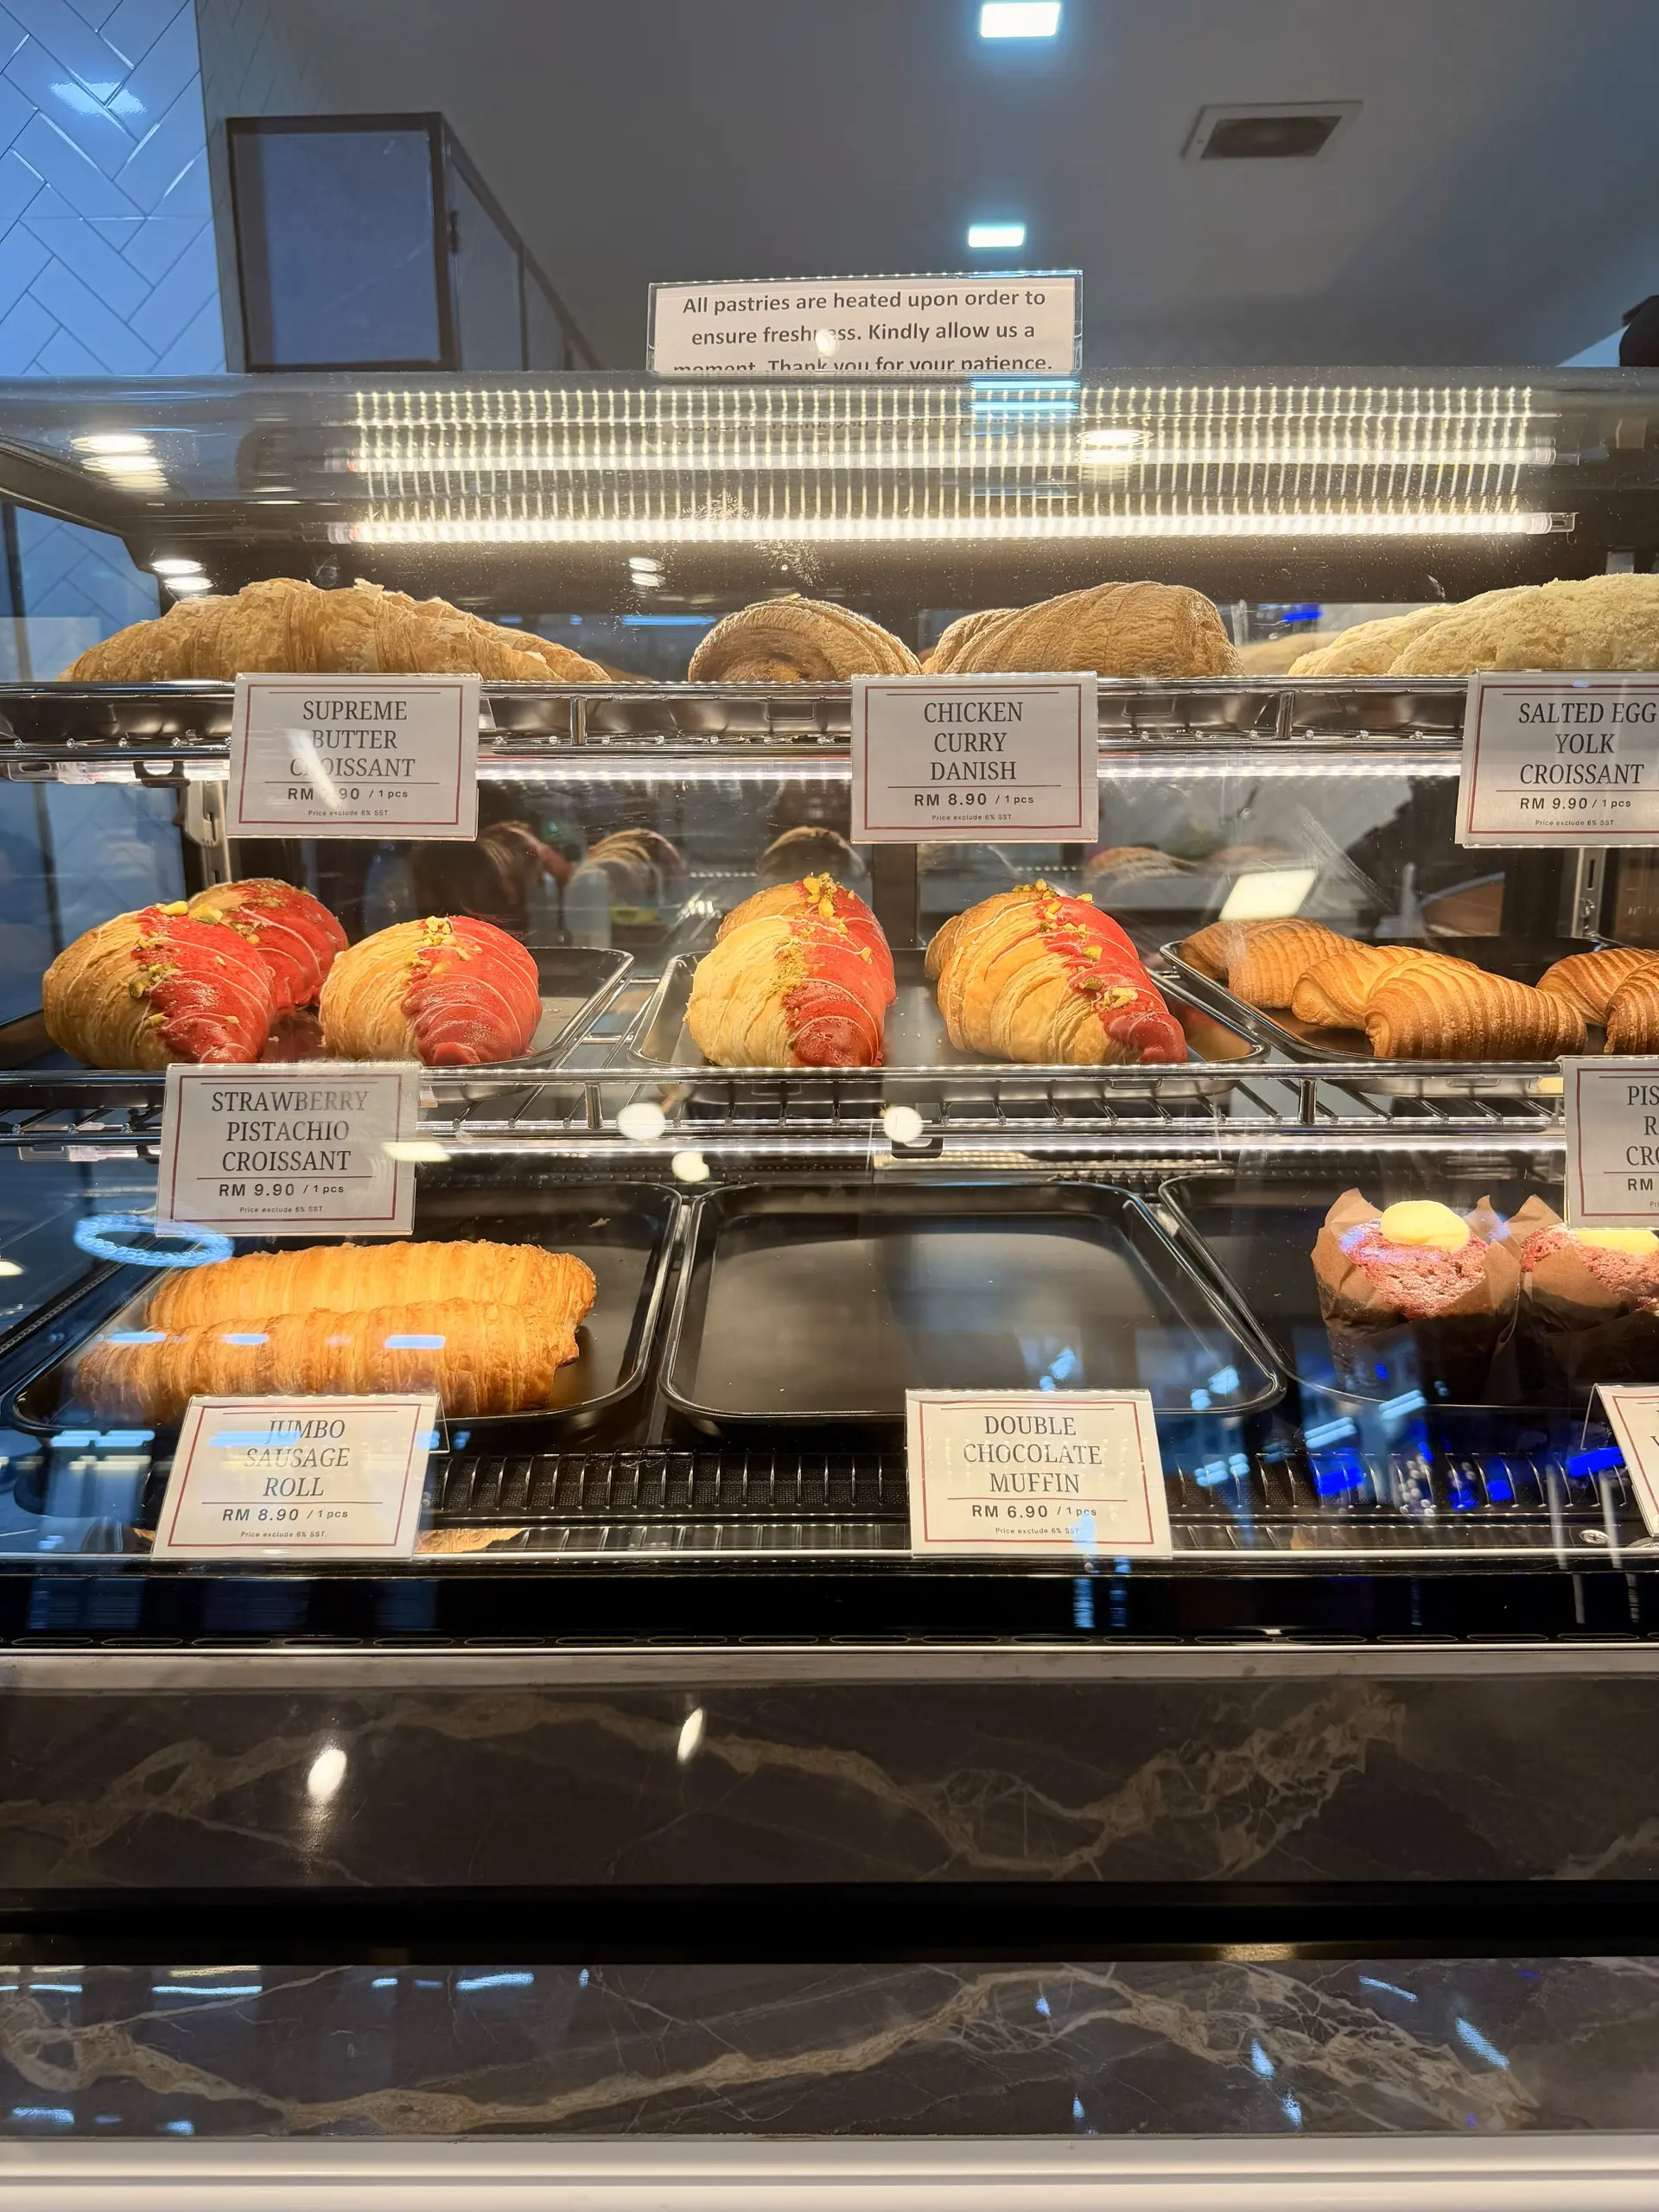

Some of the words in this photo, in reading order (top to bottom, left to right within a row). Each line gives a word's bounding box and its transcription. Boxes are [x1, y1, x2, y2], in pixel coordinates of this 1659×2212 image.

[683, 297, 708, 314] All
[715, 294, 790, 315] pastries
[796, 295, 827, 309] are
[833, 292, 901, 308] heated
[907, 292, 958, 311] upon
[964, 289, 1020, 307] order
[1025, 290, 1046, 305] to
[691, 332, 757, 345] ensure
[763, 325, 861, 343] freshss.
[868, 322, 930, 342] Kindly
[936, 321, 990, 339] allow
[996, 325, 1018, 338] us
[1024, 325, 1035, 338] a
[302, 701, 407, 720] SUPREME
[924, 702, 1023, 723] CHICKEN
[1518, 702, 1604, 723] SALTED
[1611, 702, 1657, 723] EGG
[312, 729, 397, 749] BUTTER
[934, 732, 1007, 753] CURRY
[1555, 733, 1616, 753] YOLK
[289, 758, 416, 777] COISSANT
[930, 761, 1016, 780] DANISH
[1520, 764, 1644, 784] CROISSANT
[288, 787, 314, 800] RM
[322, 787, 360, 800] 90
[914, 794, 940, 806] RM
[948, 792, 987, 806] 8.90
[1520, 798, 1545, 810] RM
[1552, 798, 1588, 810] 9.90
[212, 1091, 370, 1112] STRAWBERRY
[1626, 1085, 1659, 1106] PIS
[226, 1121, 350, 1141] PISTACHIO
[222, 1150, 351, 1172] CROISSANT
[219, 1184, 246, 1197] RM
[254, 1183, 295, 1196] 9.90
[1627, 1178, 1653, 1191] RM
[264, 1420, 346, 1445] JUMBO
[983, 1415, 1077, 1436] DOUBLE
[245, 1447, 351, 1468] SAUSAGE
[963, 1443, 1103, 1465] CHOCOLATE
[262, 1477, 325, 1497] ROLL
[989, 1472, 1080, 1493] MUFFIN
[222, 1509, 251, 1522] RM
[257, 1508, 300, 1522] 8.90
[971, 1504, 999, 1518] RM
[1007, 1505, 1048, 1518] 6.90
